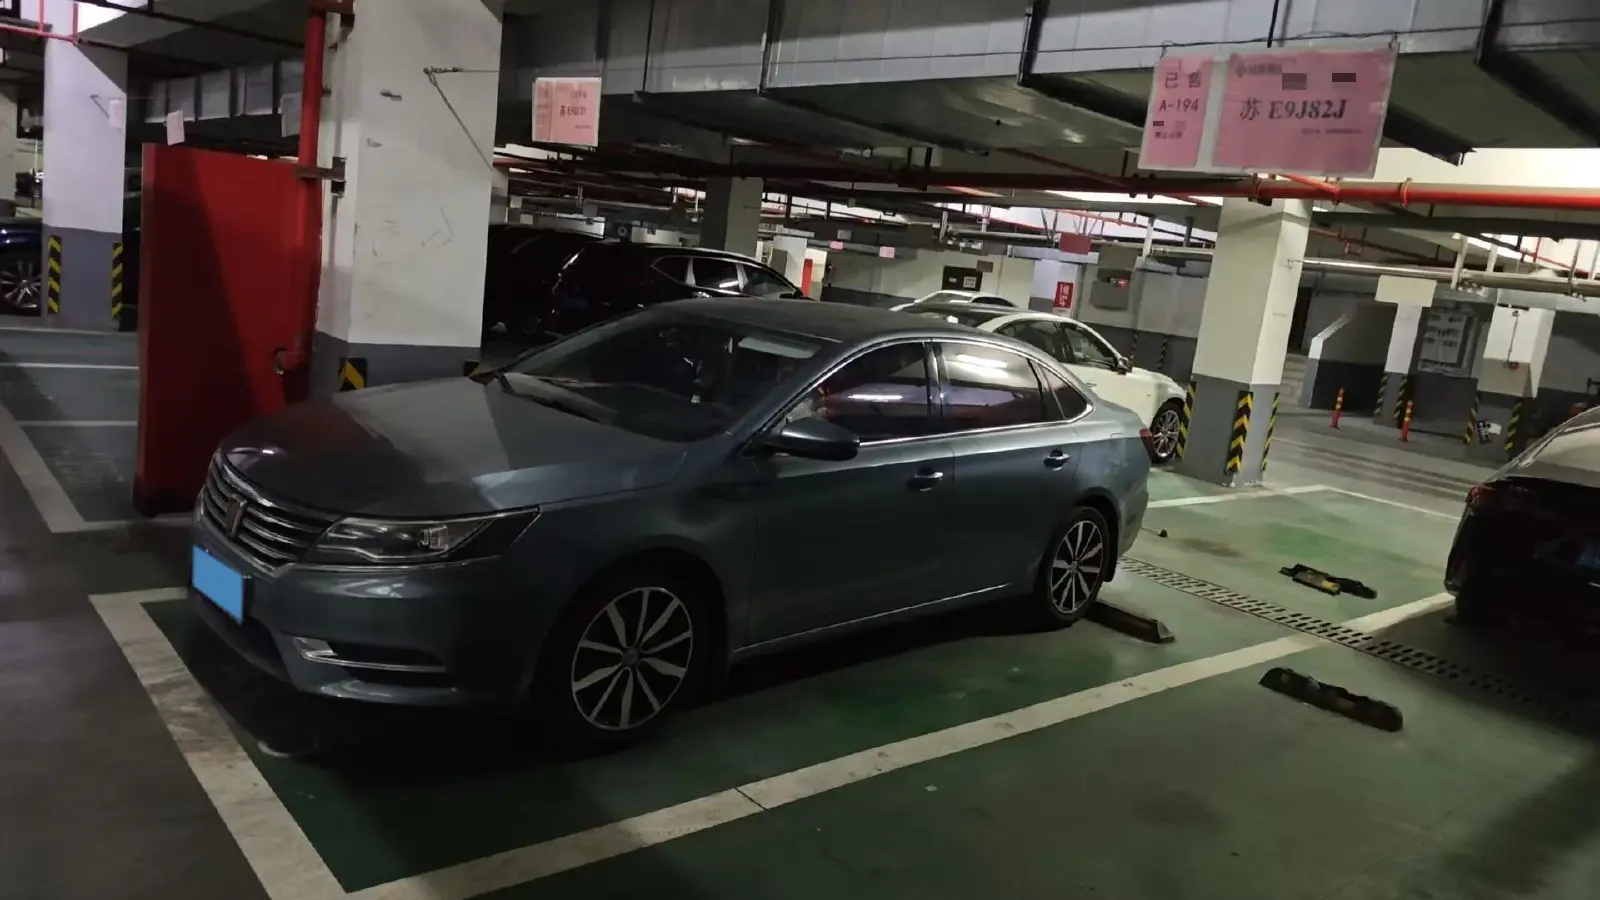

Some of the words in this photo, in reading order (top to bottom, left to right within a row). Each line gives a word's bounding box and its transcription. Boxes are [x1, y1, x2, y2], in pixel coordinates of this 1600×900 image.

[1158, 97, 1199, 113] A-194
[1240, 97, 1261, 120] 苏
[1268, 98, 1348, 120] E9J82J
